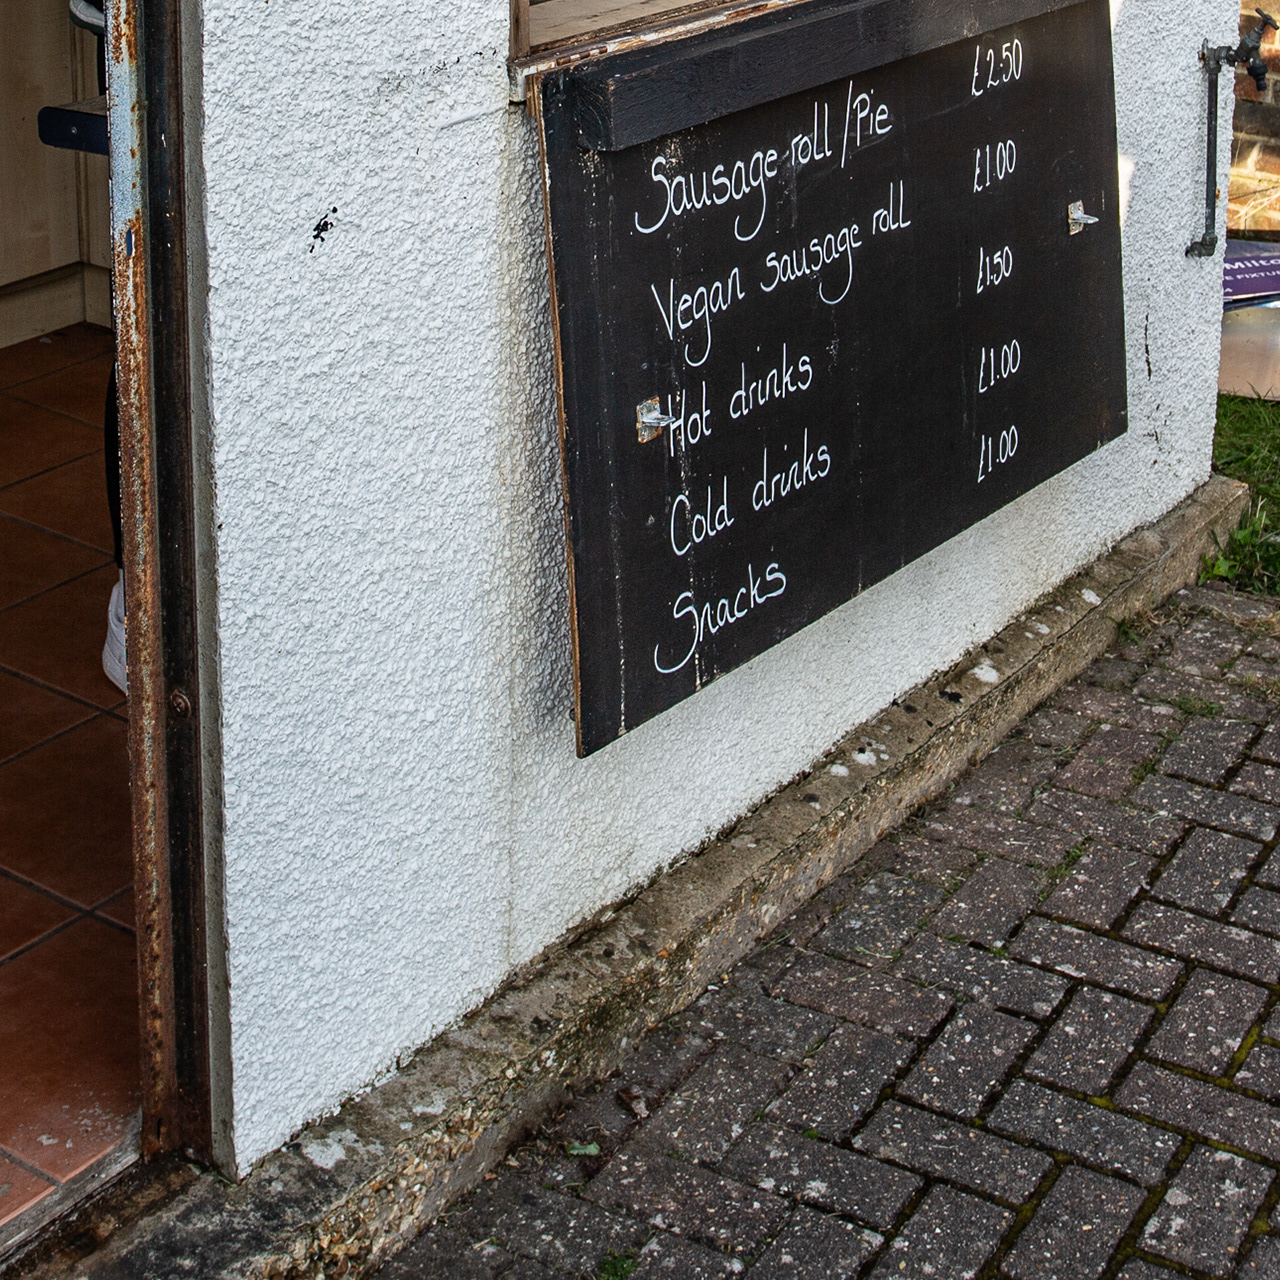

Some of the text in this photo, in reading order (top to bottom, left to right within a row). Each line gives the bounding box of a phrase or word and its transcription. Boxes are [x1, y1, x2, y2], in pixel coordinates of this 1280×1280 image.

[634, 149, 779, 242] Sausage
[791, 101, 833, 166] roll
[971, 39, 1023, 97] £2.50
[651, 139, 1017, 367] Vegan sausage roll £1.00
[668, 245, 1013, 457] Hot drinks £1.50
[654, 425, 1018, 674] Snacks £1.00
[670, 339, 1021, 556] Cold drinks £1.00
